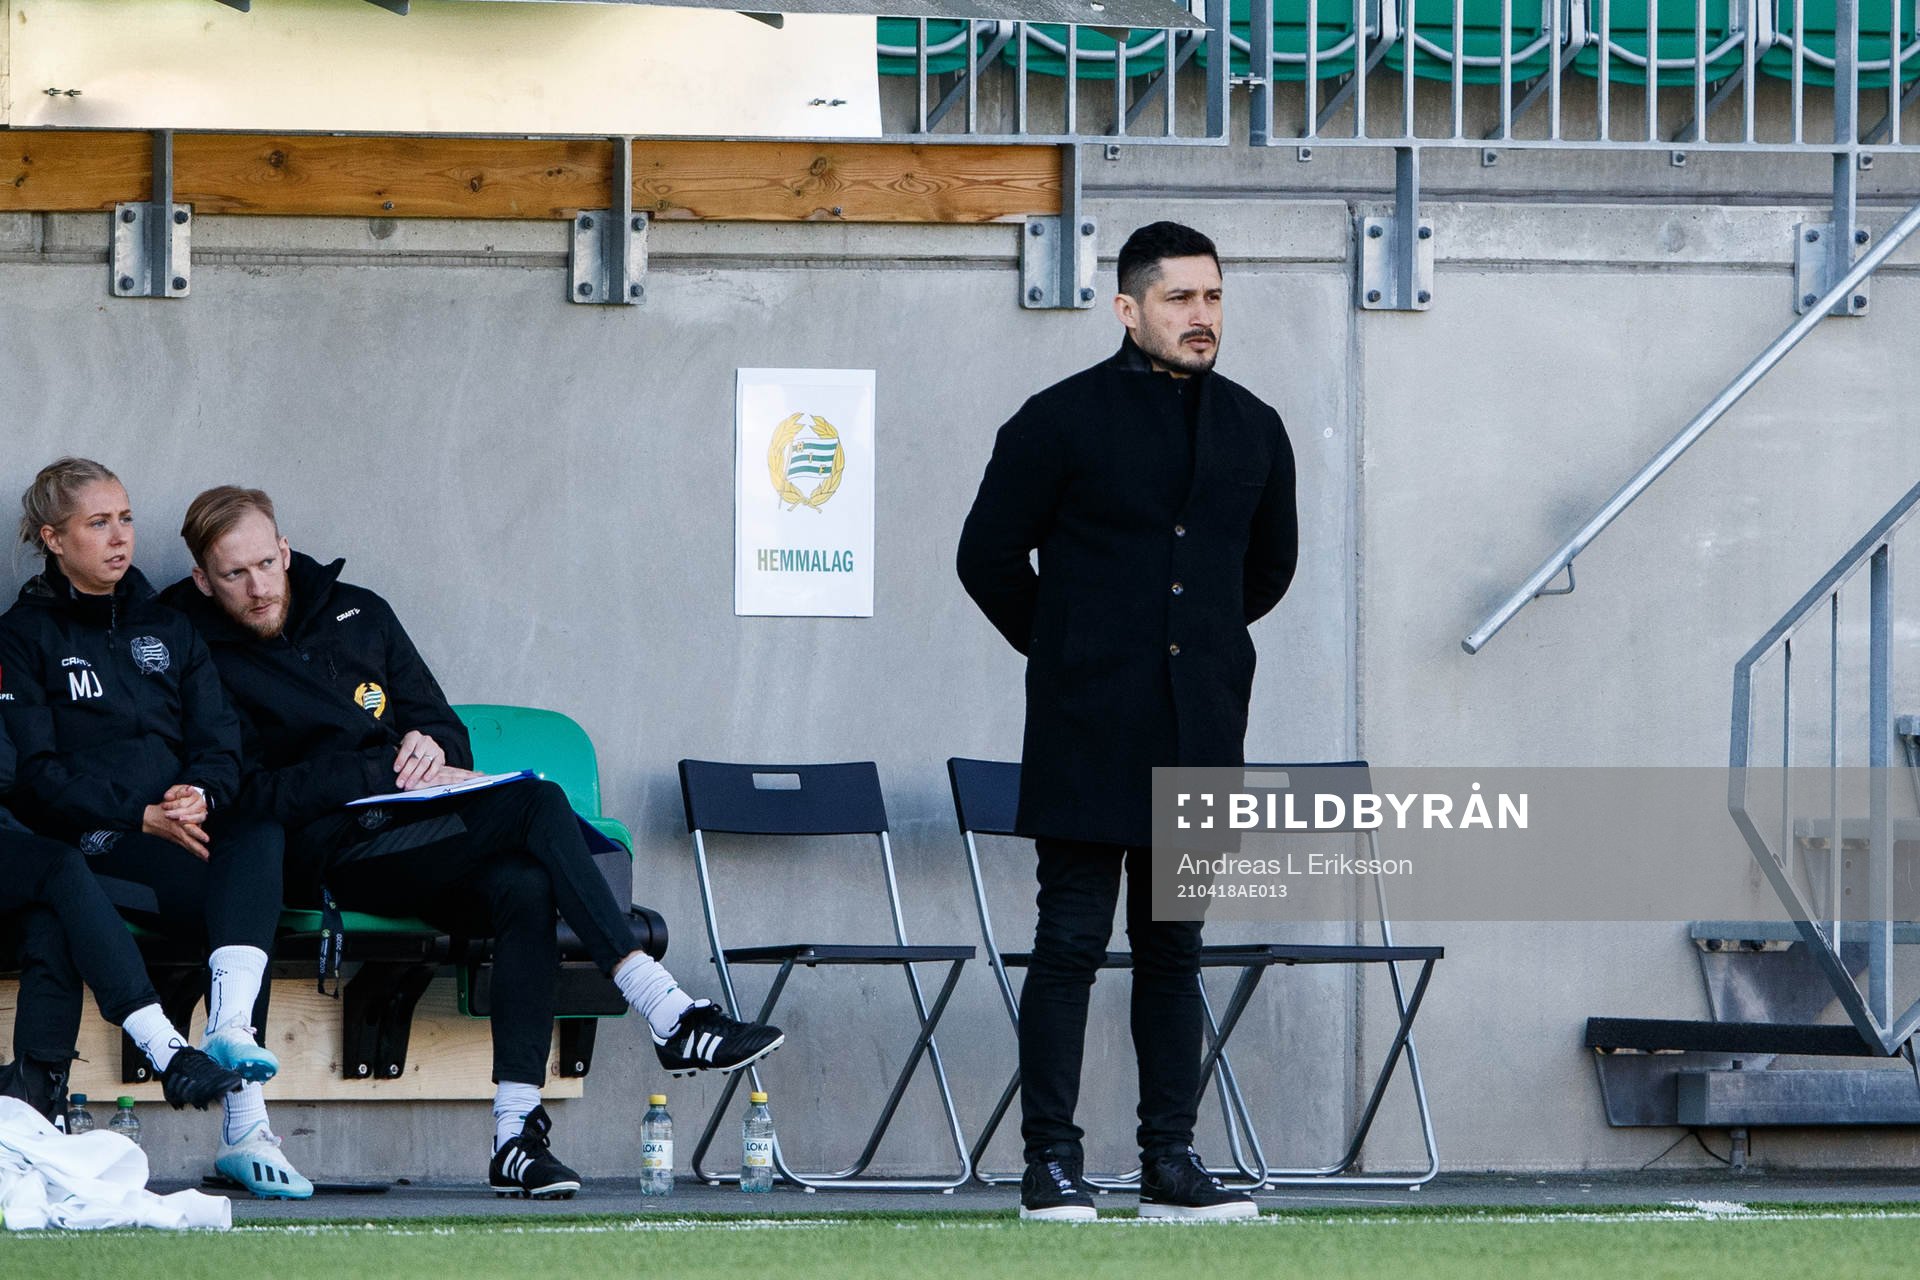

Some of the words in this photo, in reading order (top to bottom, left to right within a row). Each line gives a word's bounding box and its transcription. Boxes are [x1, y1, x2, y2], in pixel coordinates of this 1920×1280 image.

[757, 548, 854, 573] HEMMALAG
[68, 669, 104, 701] MJ
[642, 1144, 664, 1153] LOKA
[746, 1142, 769, 1151] LOKA
